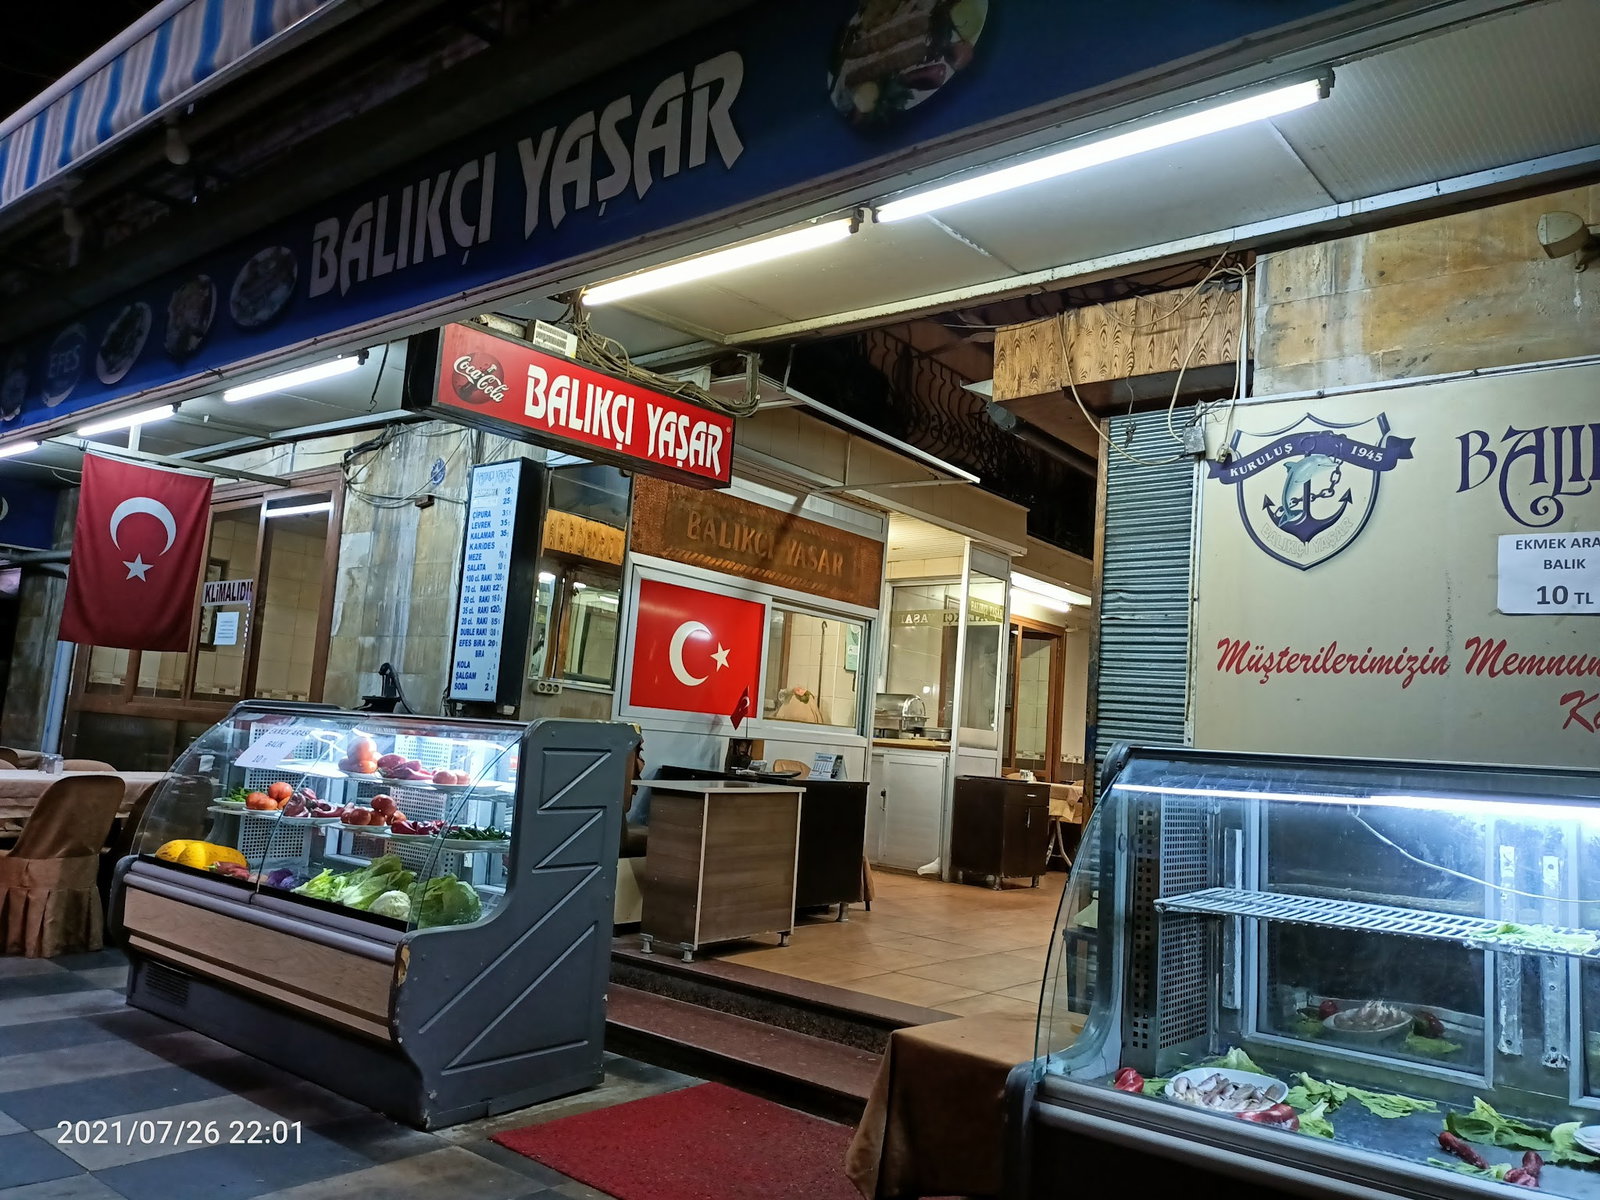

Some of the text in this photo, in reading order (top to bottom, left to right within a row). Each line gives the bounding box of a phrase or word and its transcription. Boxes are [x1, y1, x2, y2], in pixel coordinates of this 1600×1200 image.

[309, 50, 744, 298] BALIKÇI YAŞAR
[524, 363, 723, 476] BALIKÇI YAŞAR
[1230, 442, 1384, 477] KURULUŞ 1945
[471, 521, 491, 529] LEVREK
[470, 531, 495, 539] KALAMAR
[1515, 538, 1566, 550] EKMEK
[1543, 558, 1586, 570] BALIK
[1536, 585, 1594, 605] 10 TL
[460, 628, 475, 636] DUBLE
[459, 639, 472, 647] EFES
[457, 661, 470, 669] KOLA
[1217, 637, 1450, 688] Müşterilerimizin
[454, 682, 468, 690] SODA
